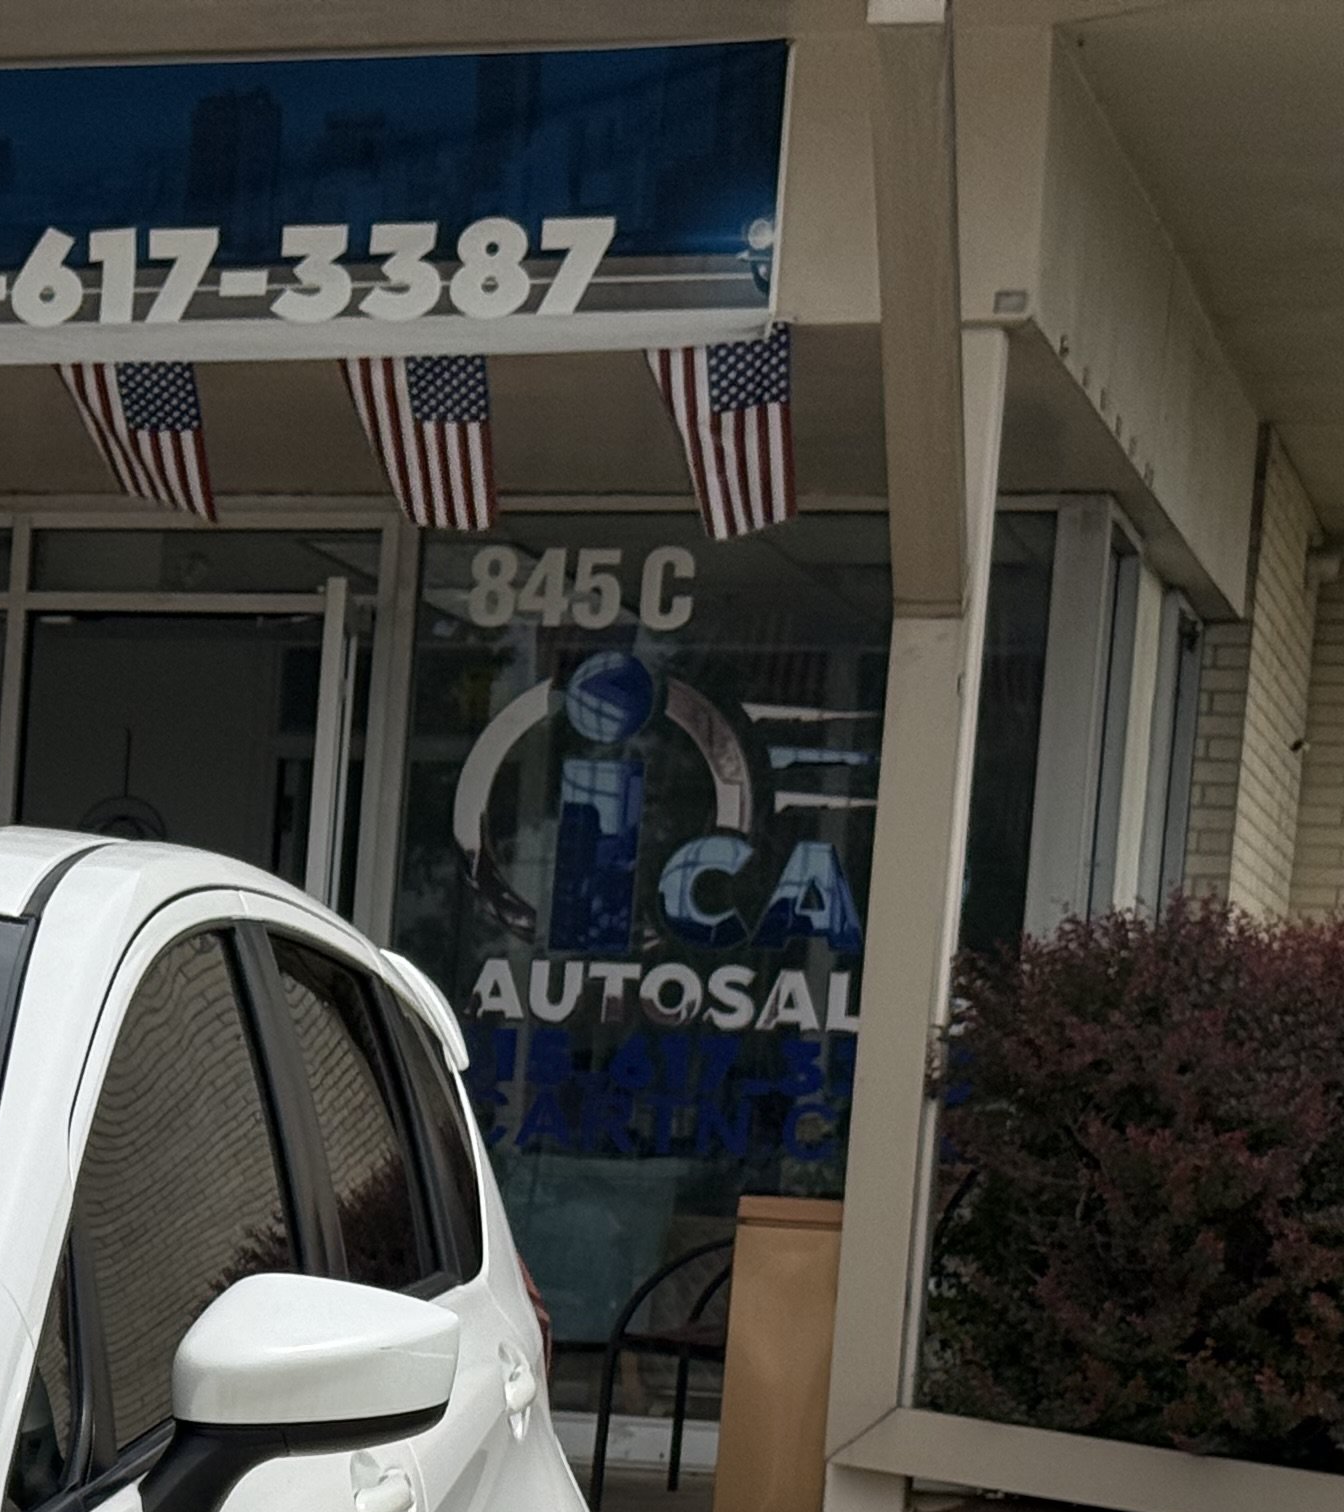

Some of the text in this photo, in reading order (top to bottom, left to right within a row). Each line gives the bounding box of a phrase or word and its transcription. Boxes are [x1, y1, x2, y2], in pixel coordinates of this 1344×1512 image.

[467, 545, 697, 632] 845 C
[465, 957, 861, 1032] AUTOSAL
